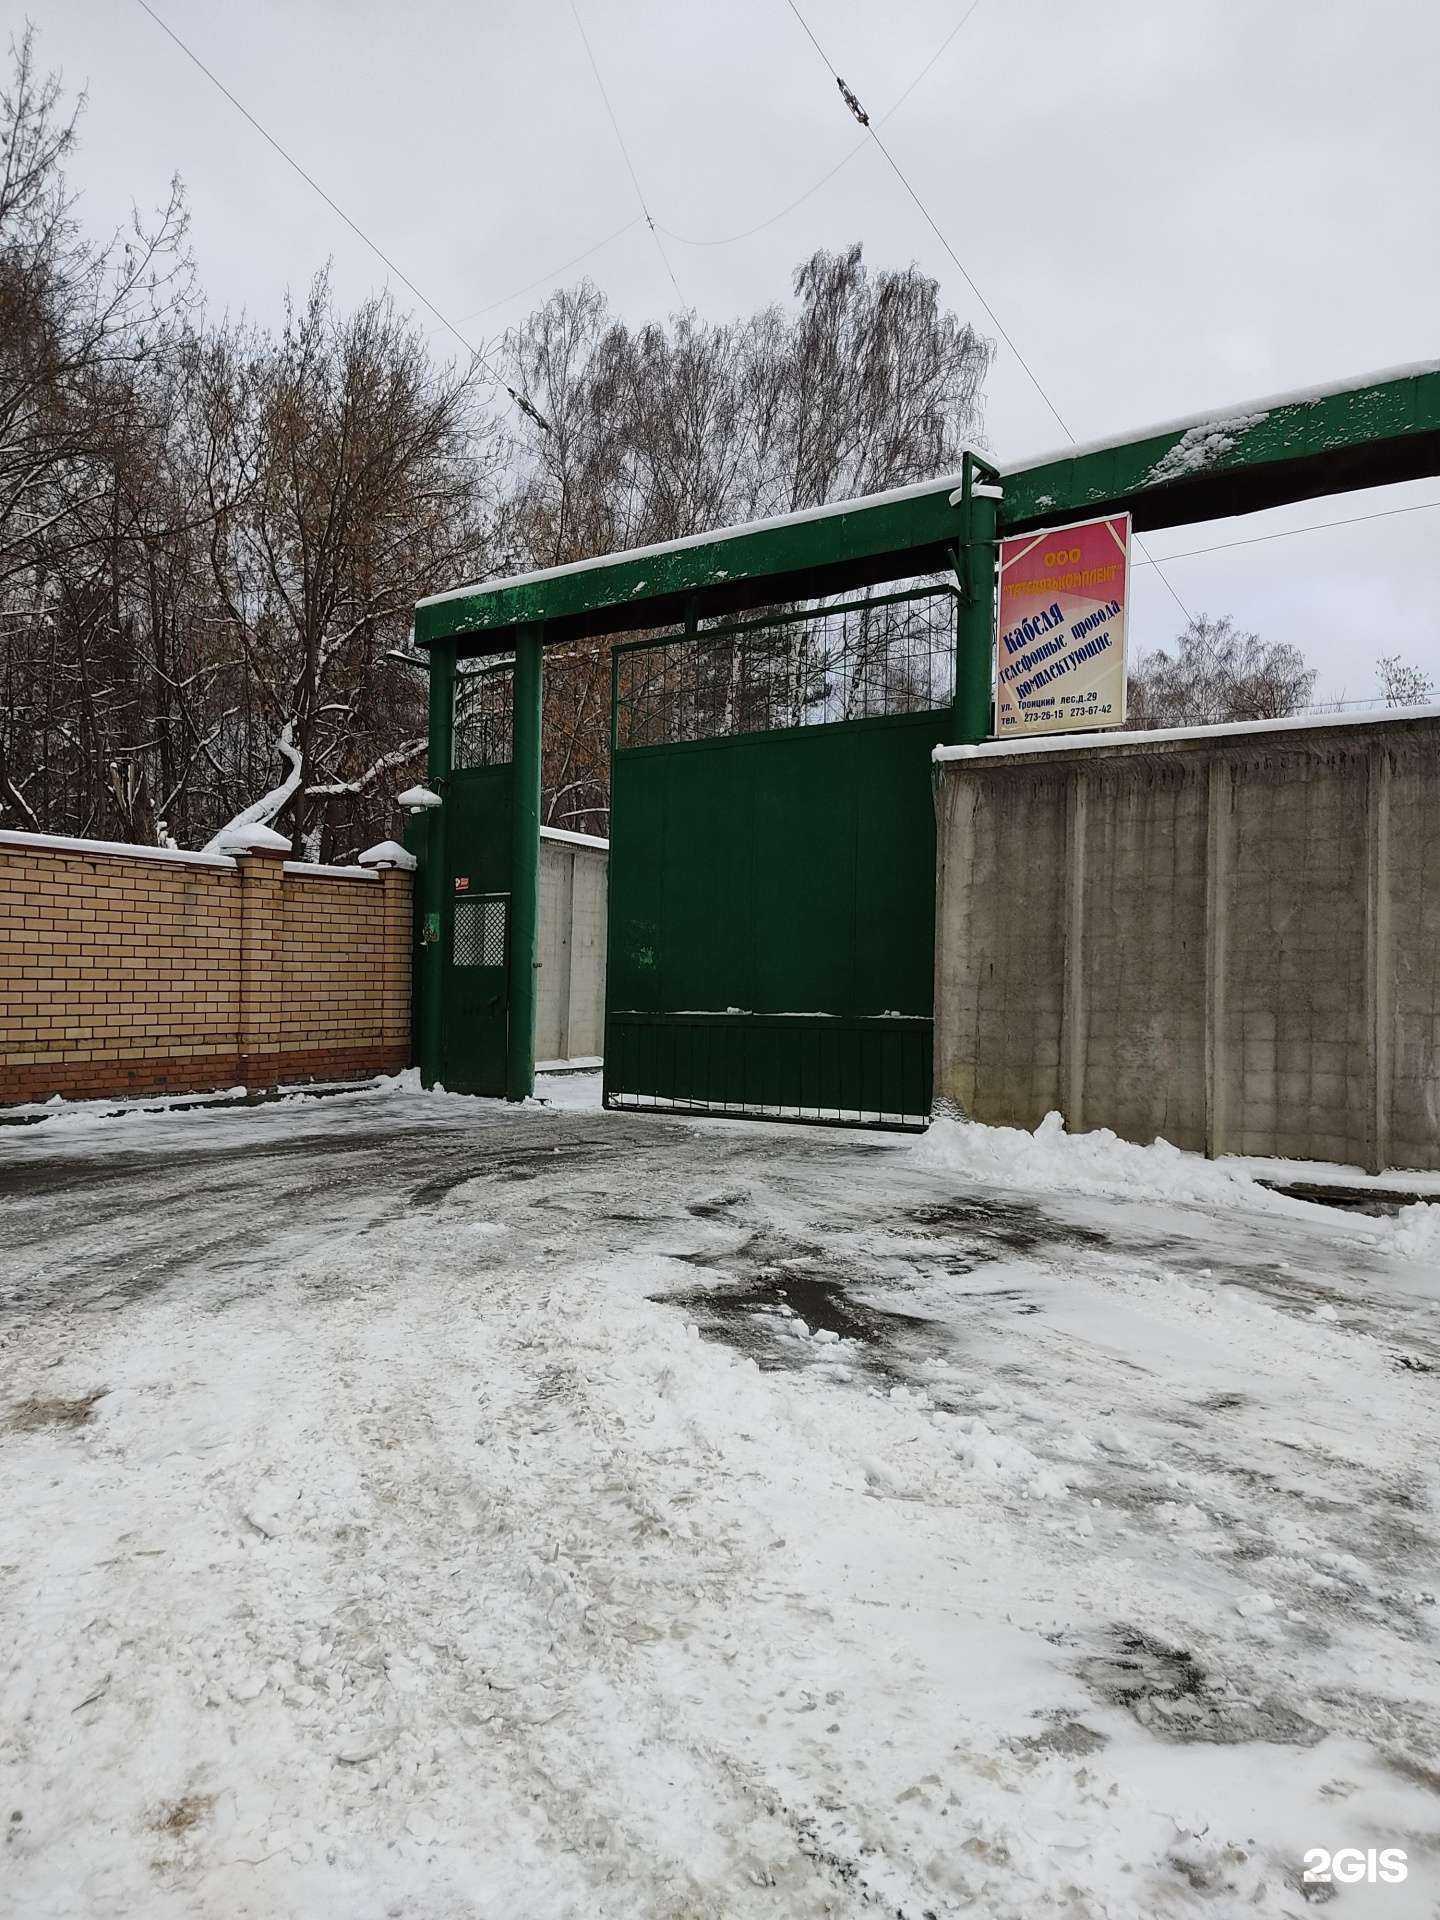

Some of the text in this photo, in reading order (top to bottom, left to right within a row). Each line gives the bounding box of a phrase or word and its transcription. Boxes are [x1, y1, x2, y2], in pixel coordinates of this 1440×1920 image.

[1044, 549, 1081, 567] ООО
[999, 600, 1121, 684] телефонные провода
[1016, 632, 1112, 699] комплектующие
[1001, 703, 1013, 713] ул.
[1018, 697, 1055, 710] Троицкий
[1001, 704, 1112, 725] тел. 273-26-15 273-67-42
